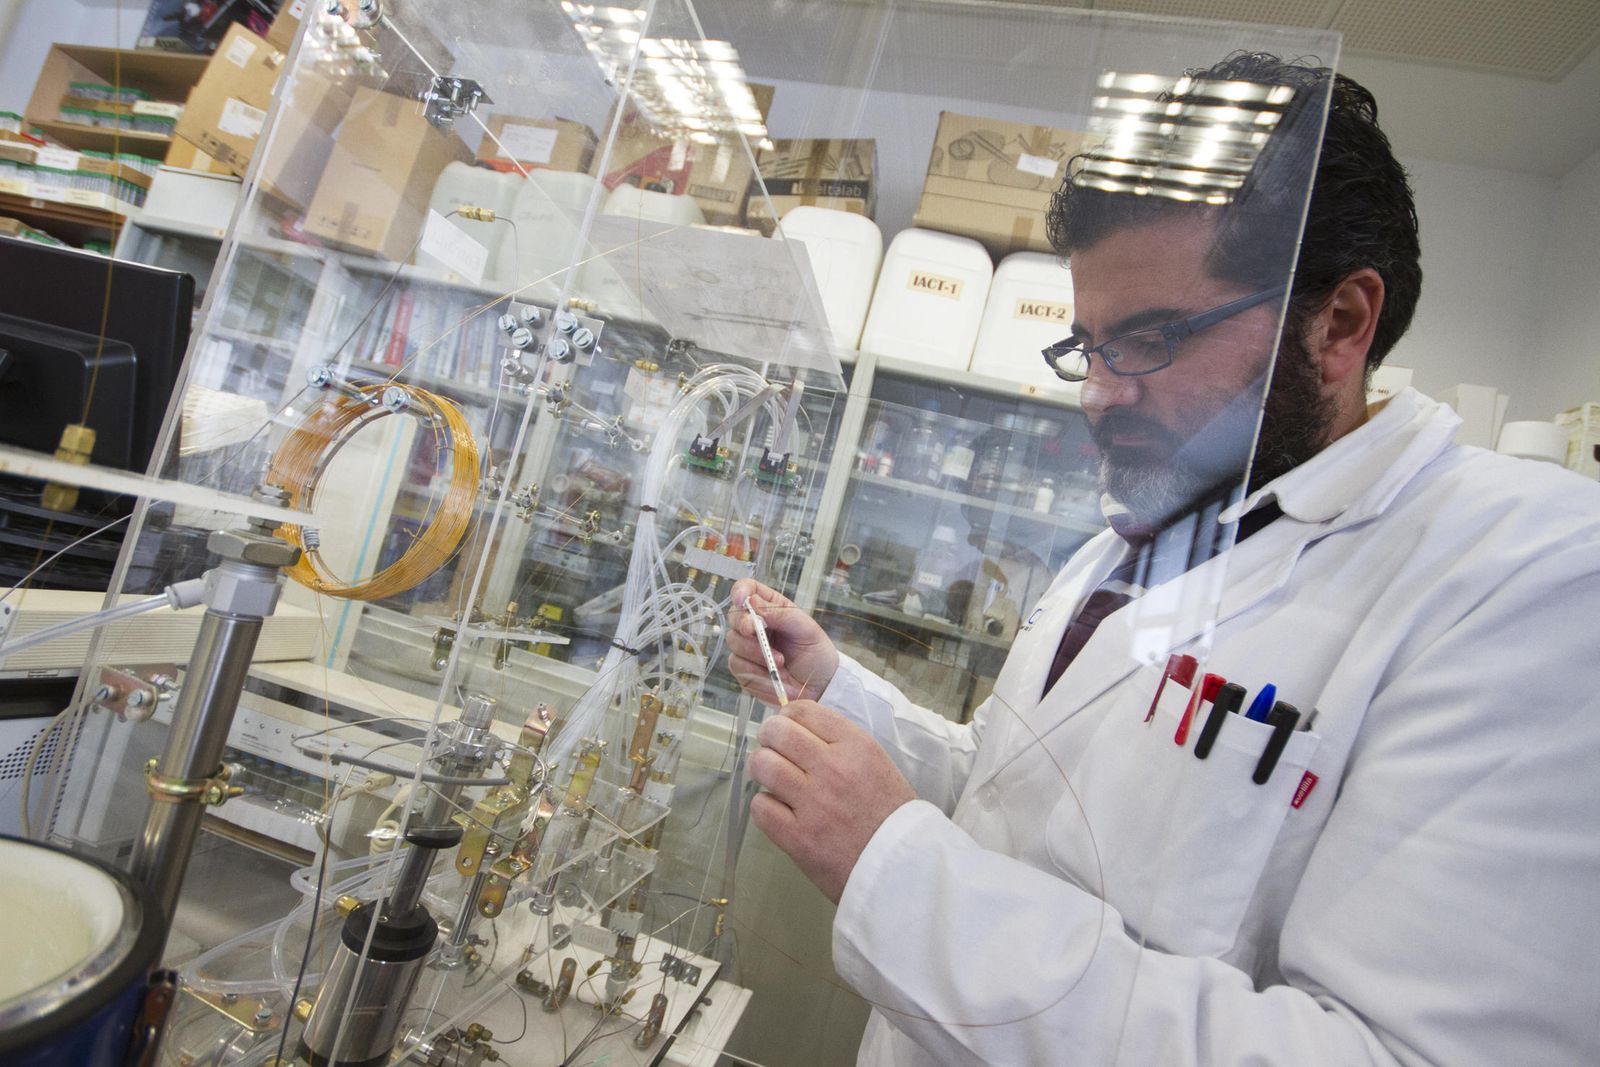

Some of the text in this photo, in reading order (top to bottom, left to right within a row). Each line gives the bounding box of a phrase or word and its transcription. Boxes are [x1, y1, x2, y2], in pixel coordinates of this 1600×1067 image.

[809, 182, 862, 197] eltalab
[912, 274, 957, 295] IACT-1
[1019, 303, 1067, 320] IACT-2
